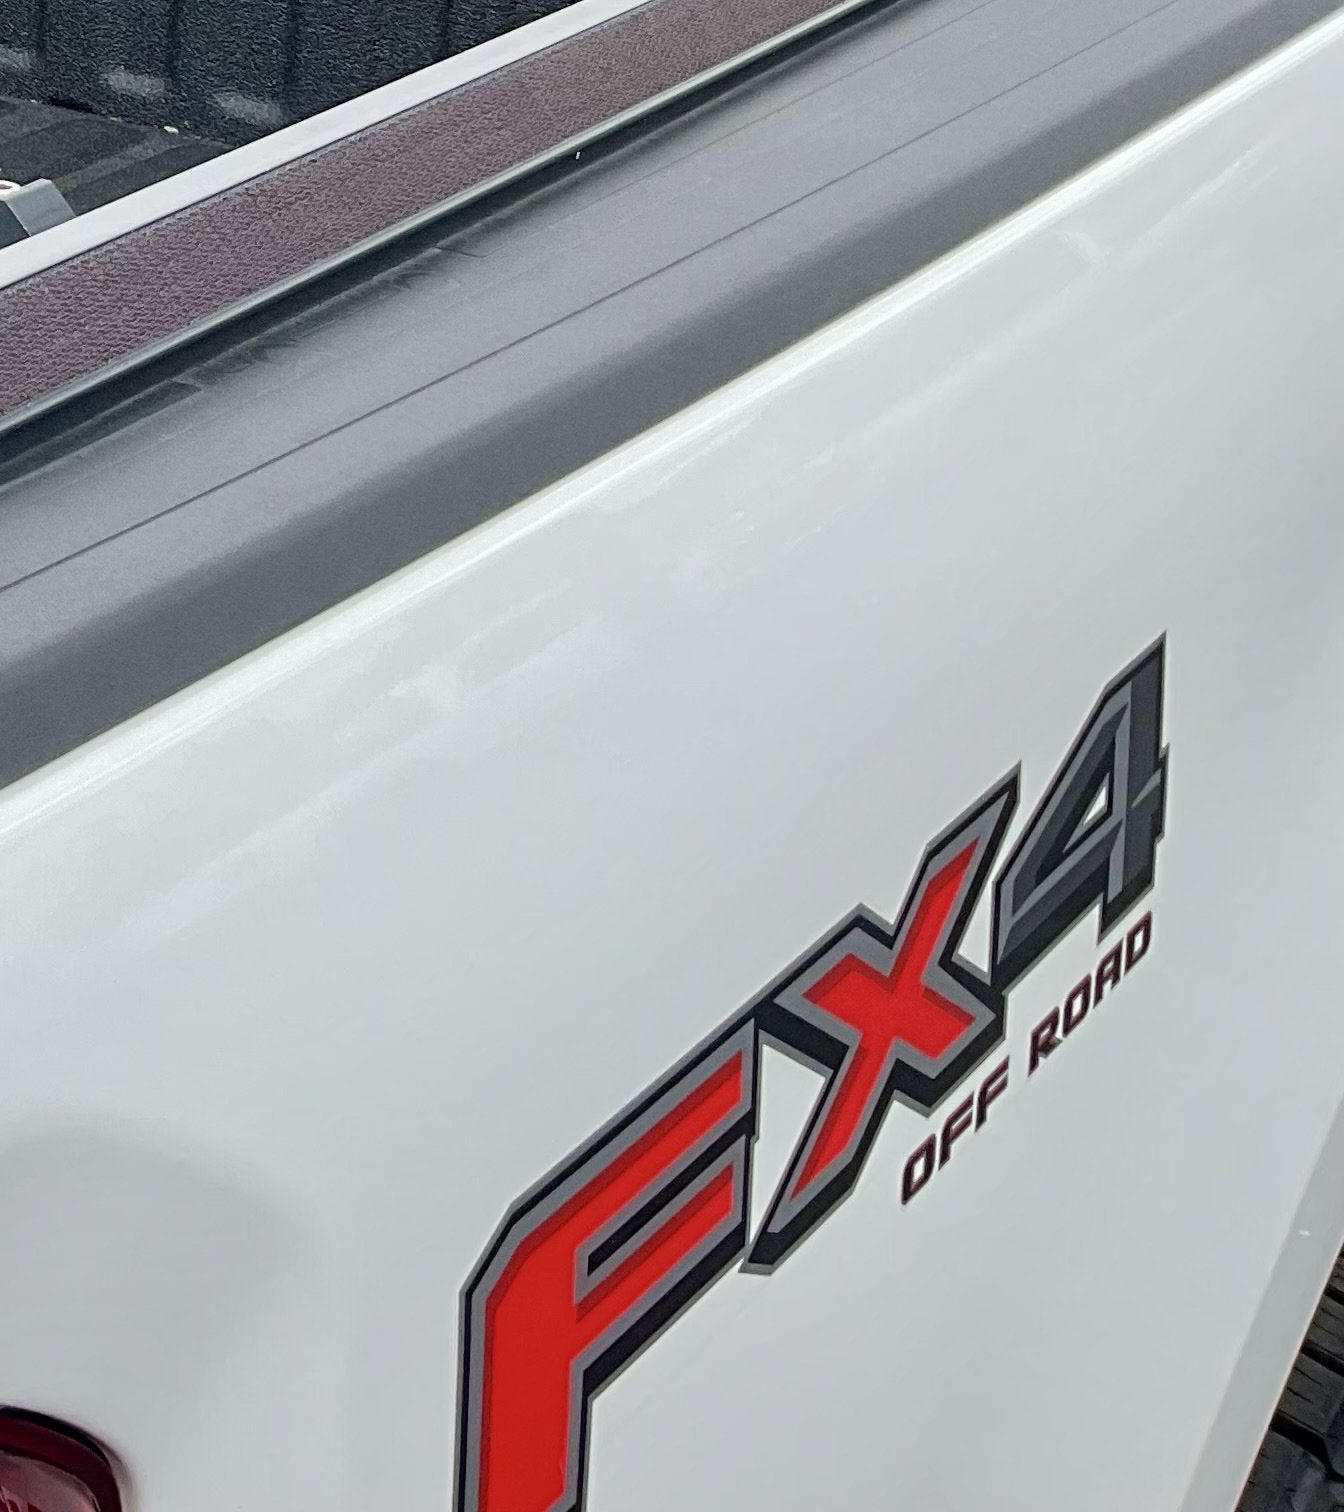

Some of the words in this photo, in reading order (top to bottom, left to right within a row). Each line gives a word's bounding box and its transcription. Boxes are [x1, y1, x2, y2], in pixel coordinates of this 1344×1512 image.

[452, 630, 1170, 1512] FX4
[901, 1054, 1011, 1207] OFF
[1027, 910, 1153, 1078] ROAD
